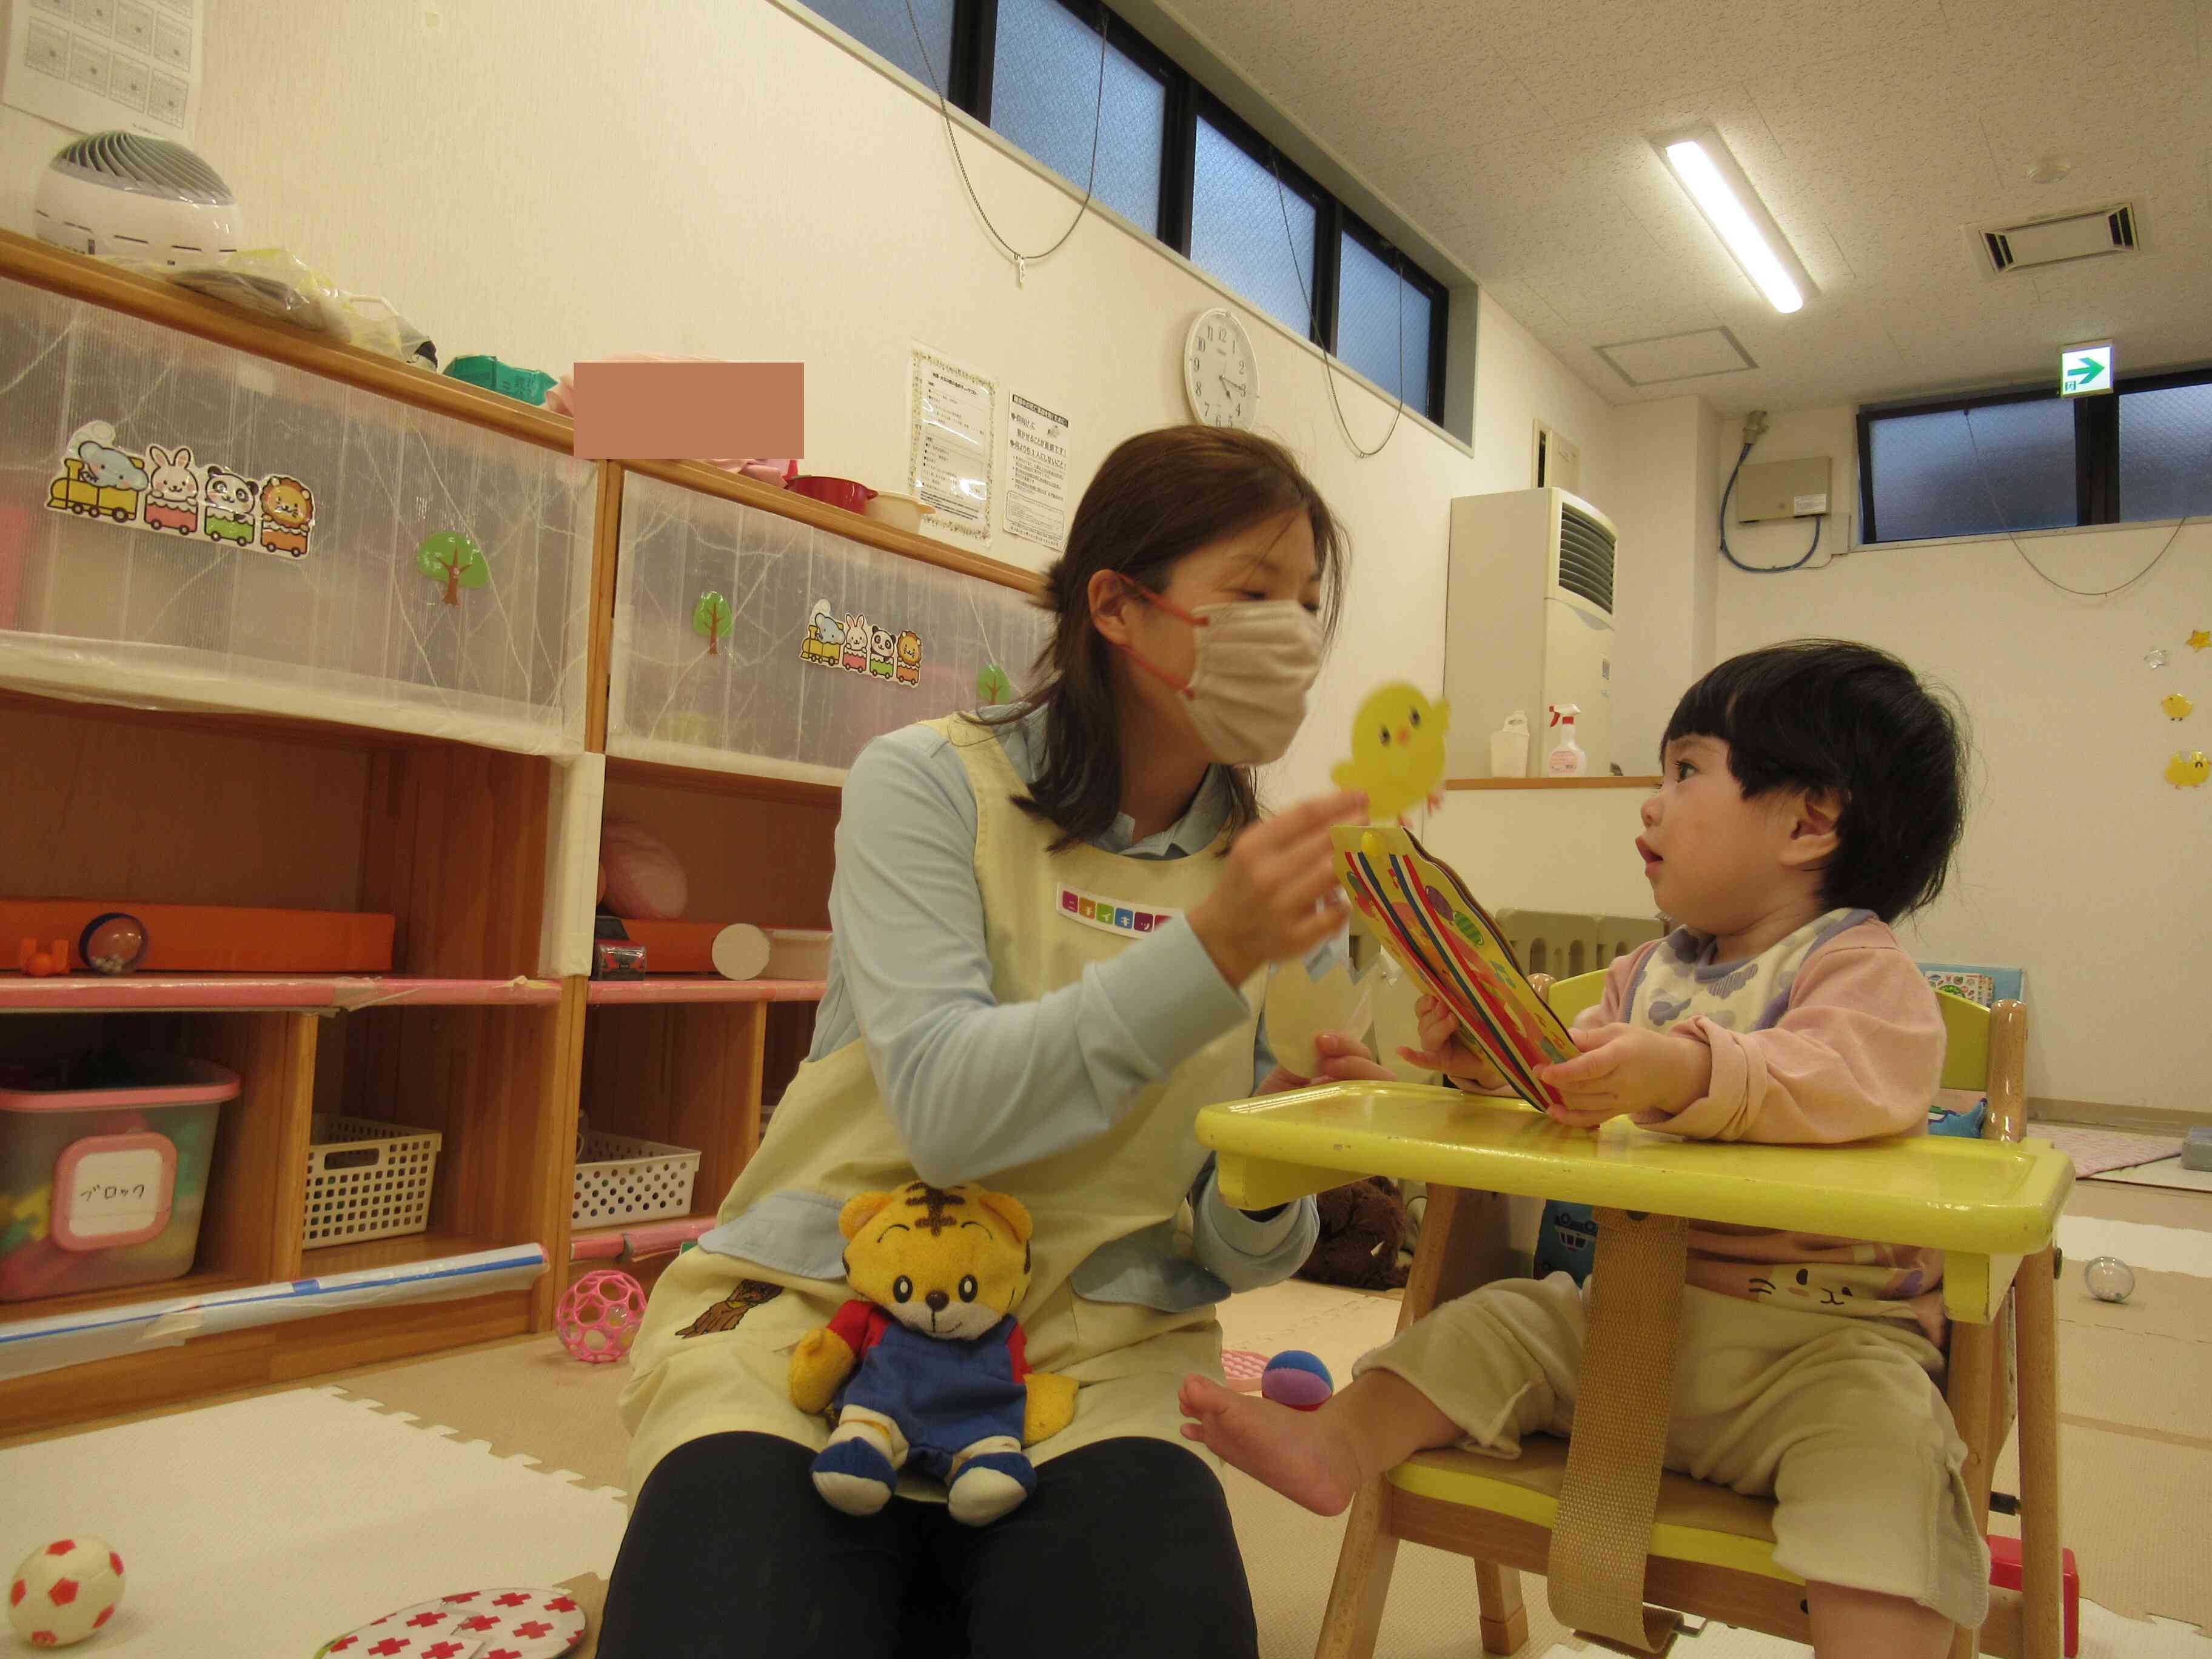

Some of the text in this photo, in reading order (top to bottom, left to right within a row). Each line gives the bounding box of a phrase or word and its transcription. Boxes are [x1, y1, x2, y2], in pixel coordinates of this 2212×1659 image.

[1208, 326, 1213, 340] 11
[1219, 327, 1227, 343] 12
[1198, 337, 1206, 353] 10
[1194, 357, 1200, 372] 9
[1239, 360, 1245, 375] 2
[1195, 382, 1202, 396] 8
[1240, 384, 1246, 398] 3
[1204, 402, 1210, 417] 7
[1236, 403, 1241, 417] 4
[1215, 414, 1221, 427] 6
[1227, 415, 1233, 427] 5
[80, 1184, 144, 1202] ブロック
